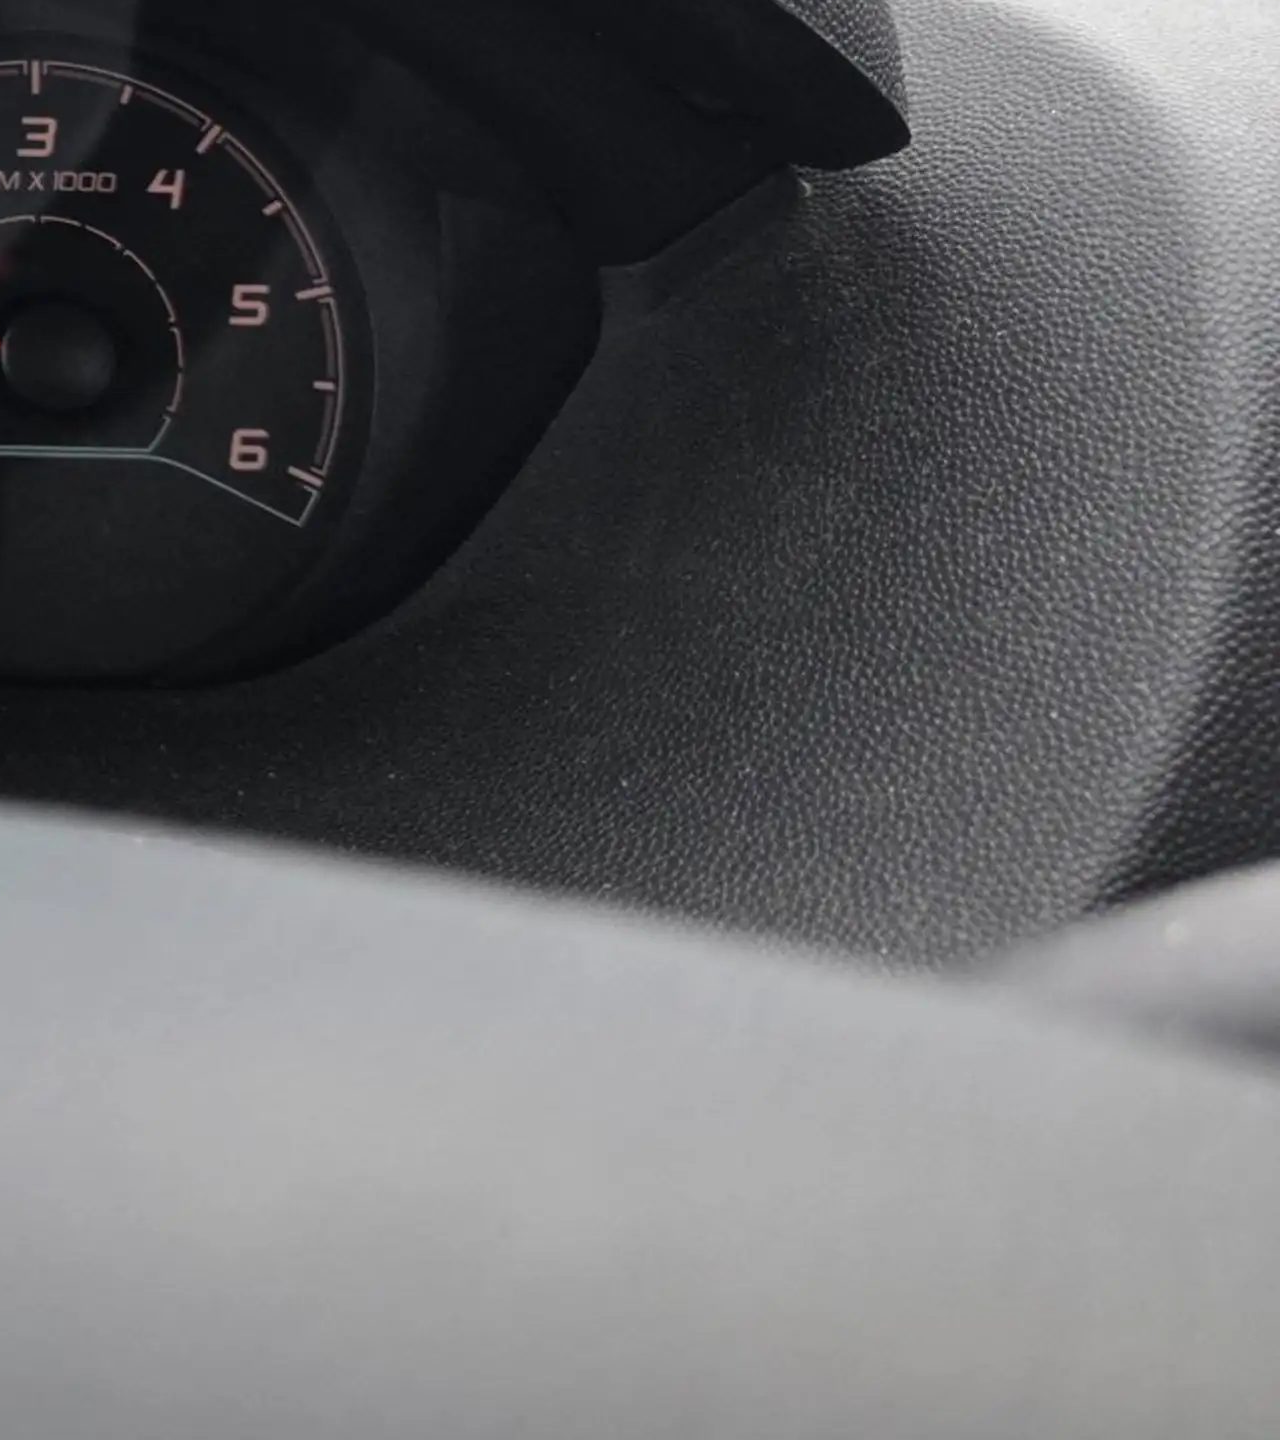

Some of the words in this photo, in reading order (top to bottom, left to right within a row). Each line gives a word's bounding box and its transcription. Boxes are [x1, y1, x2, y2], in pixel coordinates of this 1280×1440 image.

[18, 117, 57, 157] 3
[28, 172, 44, 190] X
[53, 170, 116, 192] 1000
[148, 170, 184, 209] 4
[230, 285, 269, 325] 5
[230, 429, 268, 470] 6
